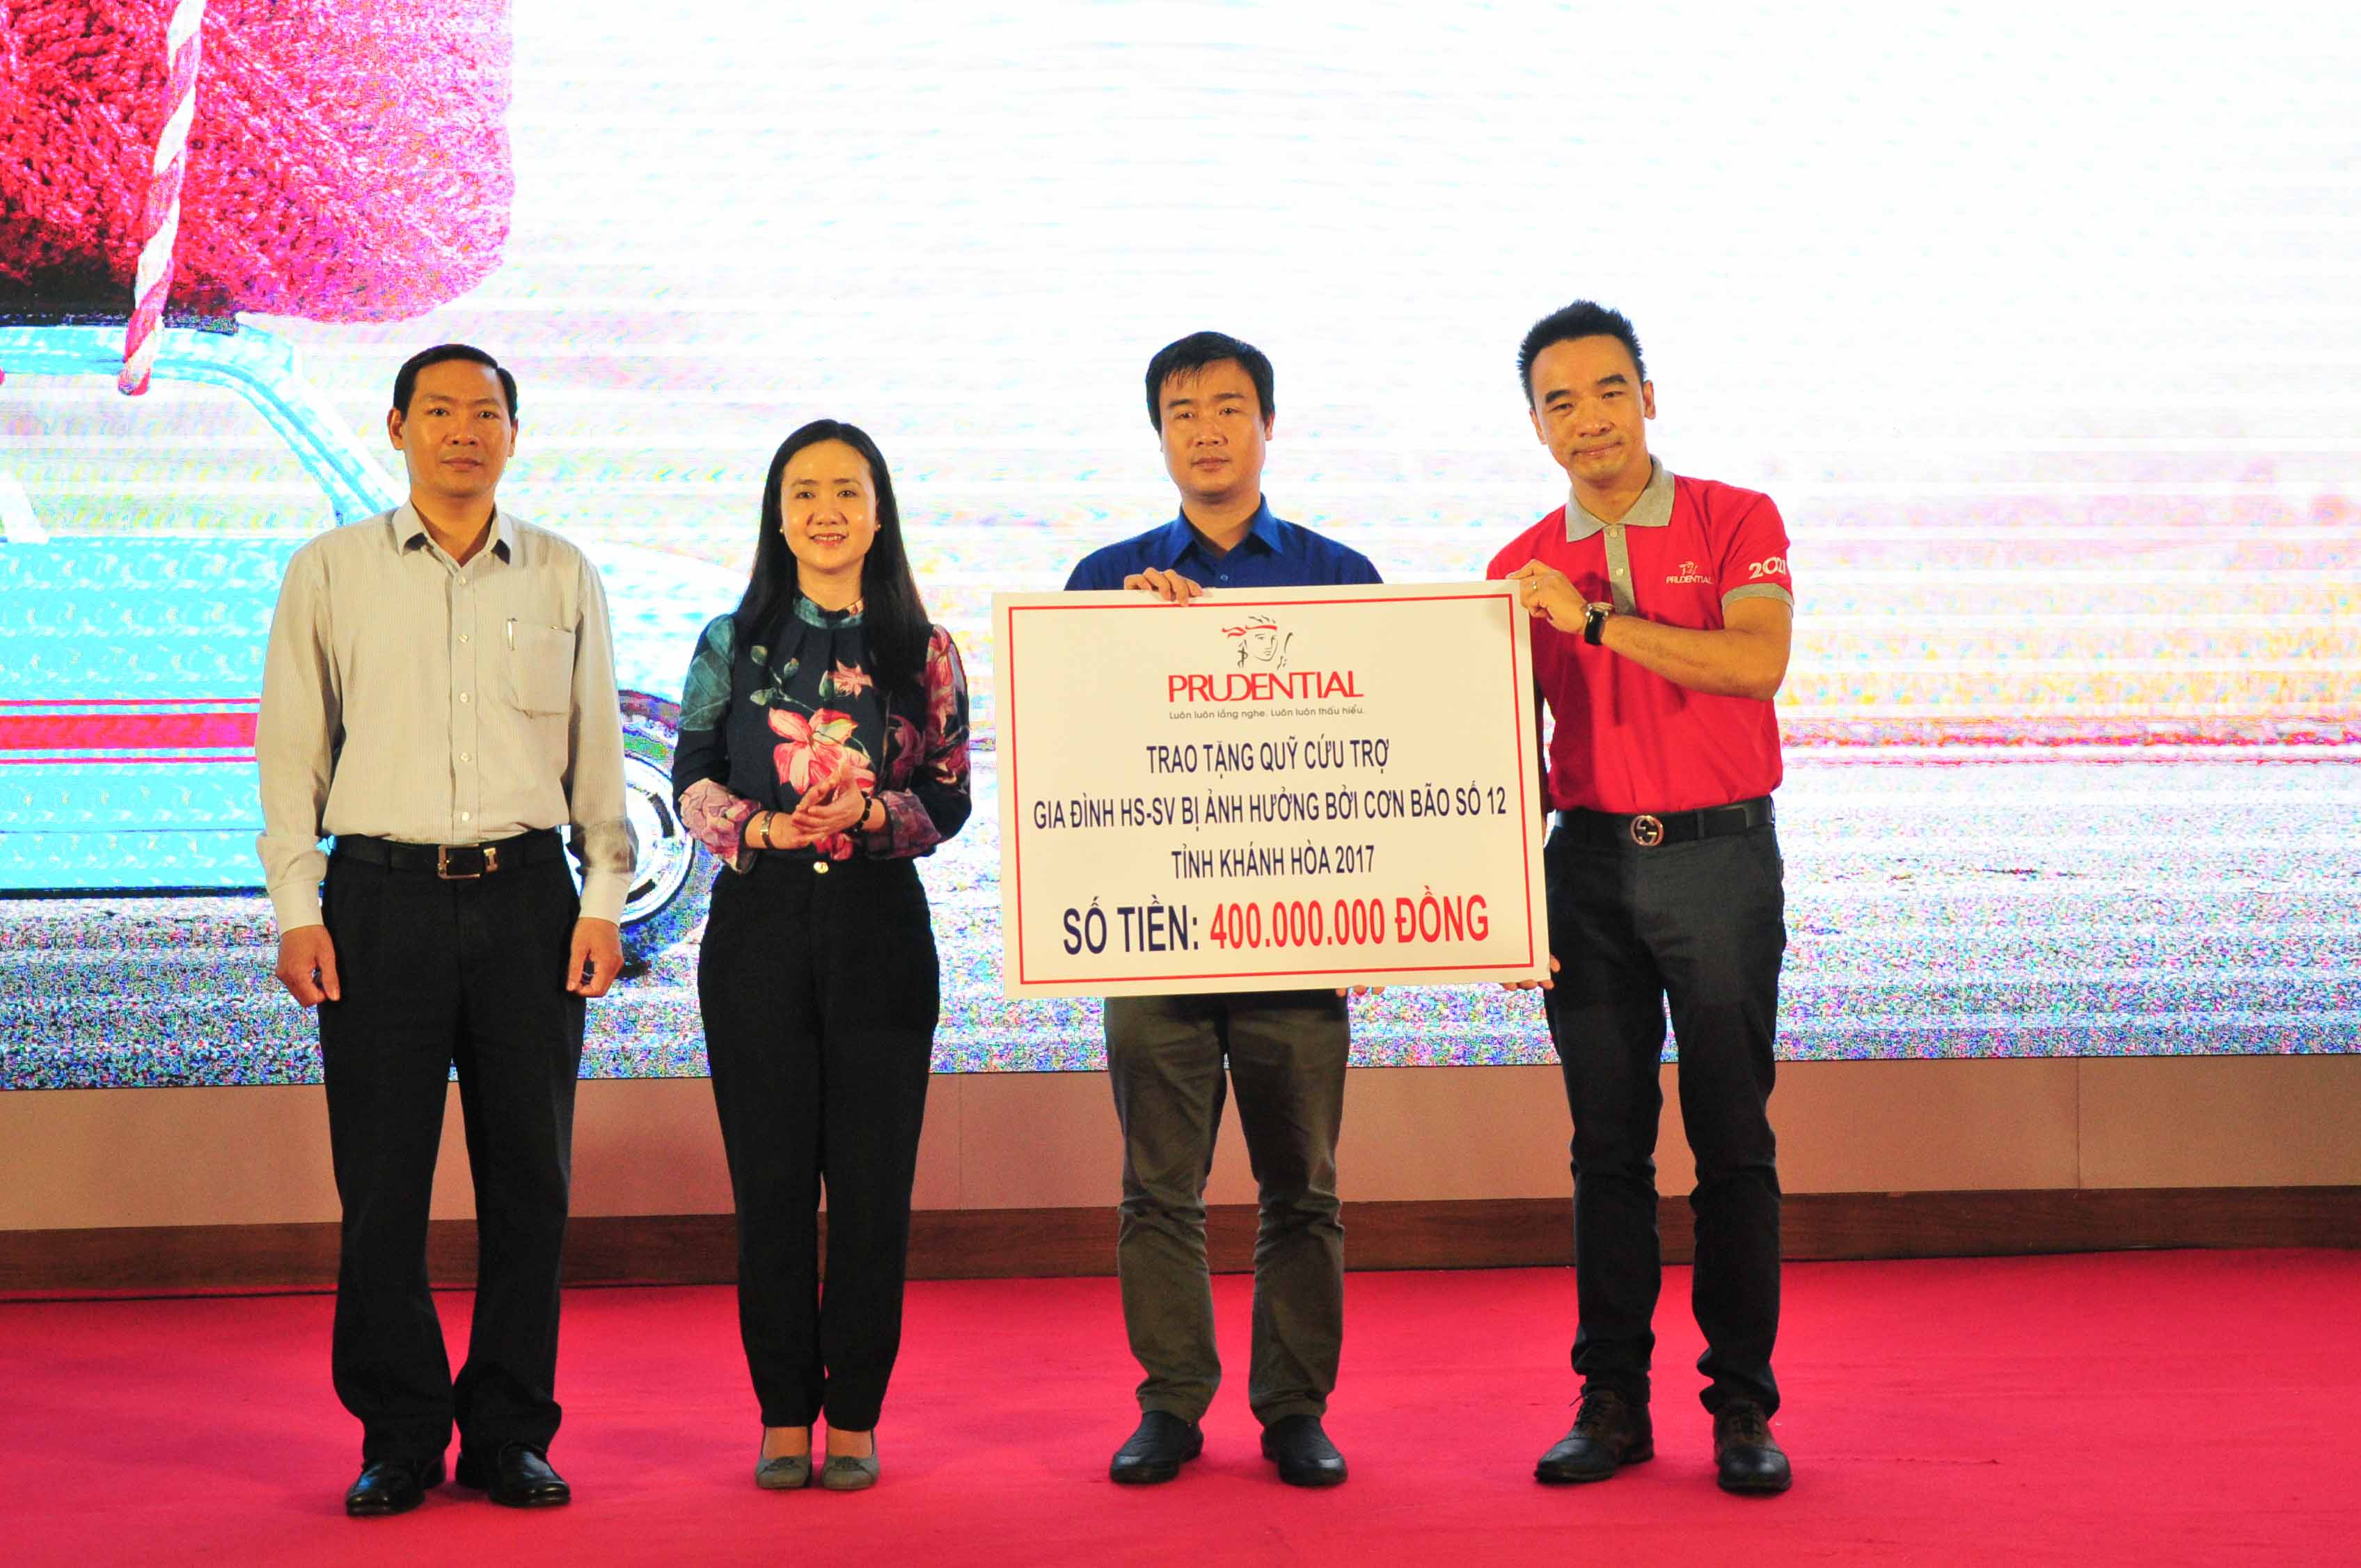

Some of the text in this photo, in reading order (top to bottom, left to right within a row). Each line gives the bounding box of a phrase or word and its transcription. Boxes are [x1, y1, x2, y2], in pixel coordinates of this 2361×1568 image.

[1666, 575, 1714, 585] PRUDENTIAL
[1168, 671, 1364, 703] PRUDENTIAL
[1169, 710, 1192, 720] Luôn
[1194, 710, 1215, 719] luôn
[1270, 707, 1293, 718] Luôn
[1295, 706, 1316, 716] luôn
[1146, 734, 1389, 779] TRAO TẶNG QUỸ CỨU TRỢ
[1034, 780, 1506, 832] GIA ĐÌNH HS-SV BỊ ẢNH HƯỞNG BỞI CƠN BÃO SỐ 12
[1171, 839, 1375, 879] TỈNH KHÁNH HÒA 2017
[1063, 885, 1489, 956] SỐ TIỀN: 400.000.000 ĐỒNG
